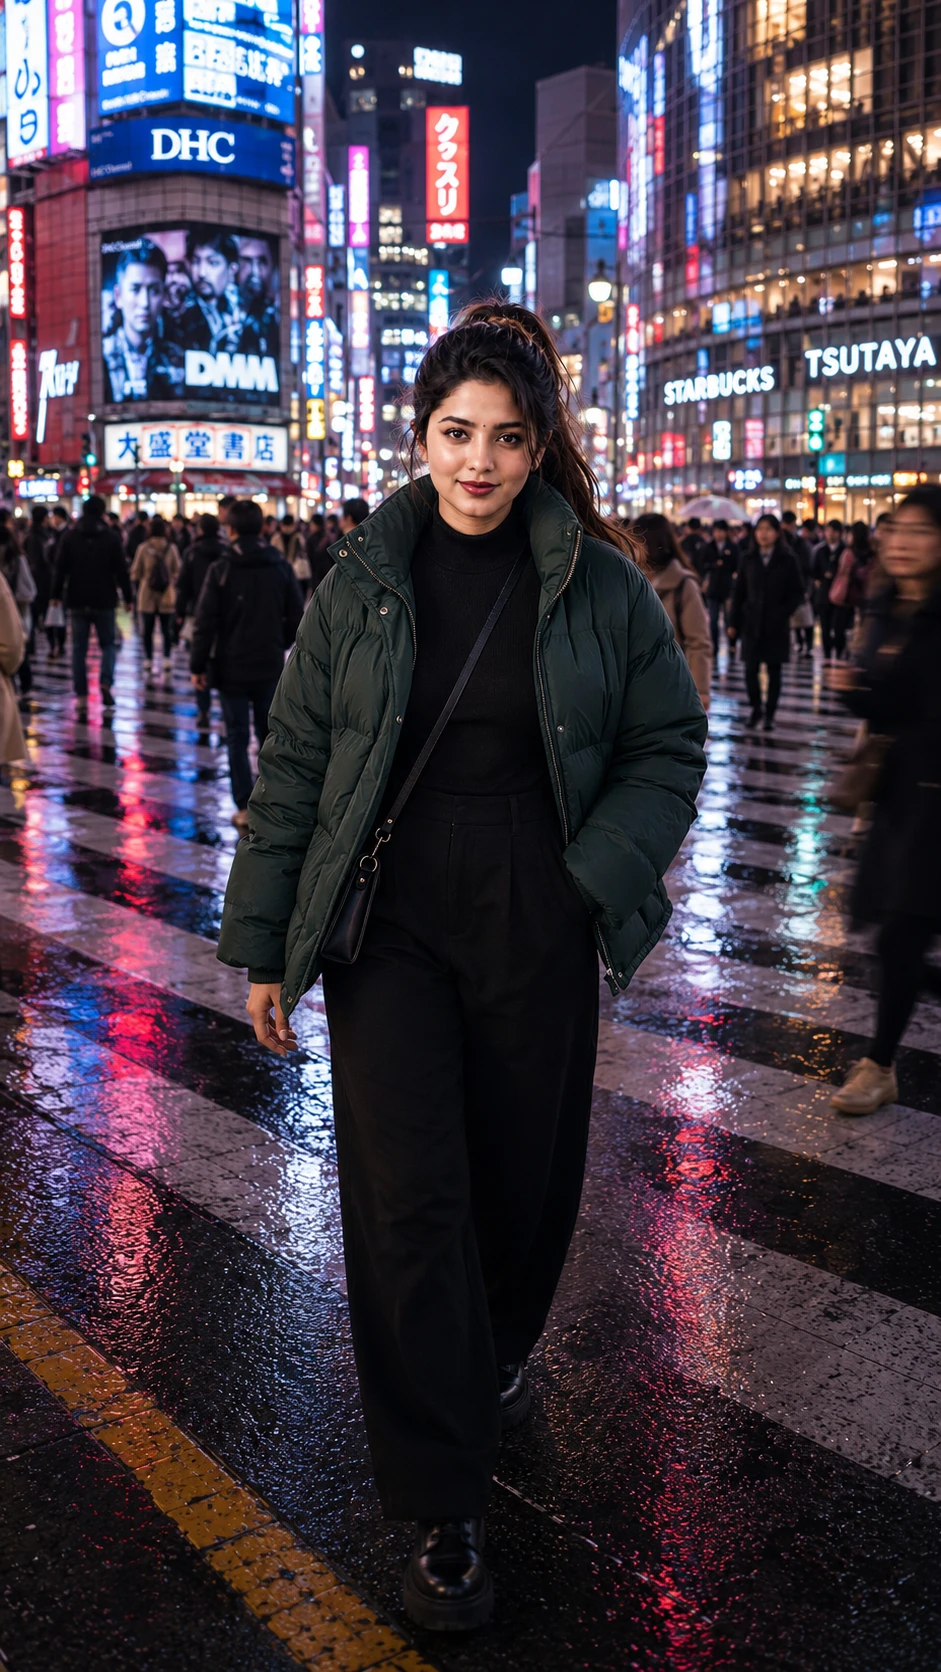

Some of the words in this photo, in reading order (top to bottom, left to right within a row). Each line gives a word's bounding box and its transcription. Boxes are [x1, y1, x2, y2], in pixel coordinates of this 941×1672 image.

[150, 128, 236, 164] DHC
[184, 349, 279, 393] DMM
[804, 335, 937, 379] TSUTAYA
[663, 365, 775, 406] STARBUCKS
[118, 431, 274, 461] 大盛堂書店
